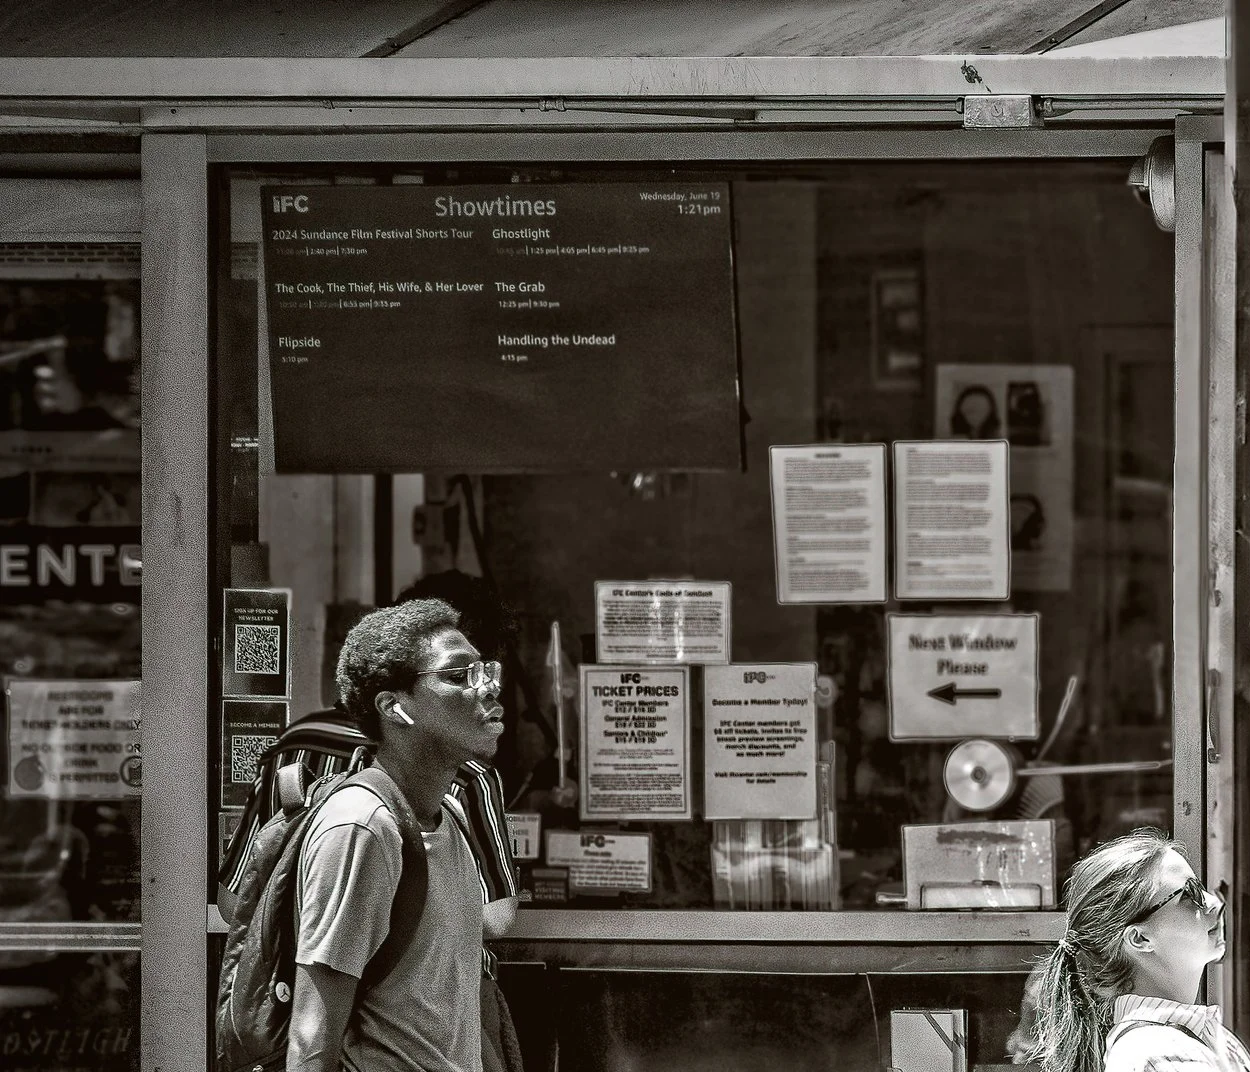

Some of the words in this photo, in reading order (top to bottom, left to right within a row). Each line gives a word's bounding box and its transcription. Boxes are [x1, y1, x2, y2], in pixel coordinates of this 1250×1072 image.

[639, 192, 687, 201] Wednesday,
[689, 192, 708, 200] June
[710, 192, 720, 200] 19
[434, 195, 556, 217] Showtimes
[272, 229, 298, 241] 2024
[300, 228, 349, 240] Sundance
[351, 228, 373, 240] Film
[375, 228, 413, 240] Festival
[416, 227, 449, 239] Shorts
[451, 228, 474, 239] Tour
[492, 228, 550, 241] Ghostlight
[275, 283, 294, 293] The
[296, 282, 325, 294] Cook,
[326, 282, 346, 293] The
[348, 282, 376, 294] Thief,
[378, 282, 394, 292] His
[397, 282, 422, 293] Wife,
[424, 282, 433, 292] &
[435, 282, 453, 292] Her
[456, 282, 484, 292] Lover
[494, 281, 516, 292] The
[518, 281, 546, 293] Grab
[278, 336, 321, 348] Flipside
[498, 334, 549, 347] Handling
[551, 334, 569, 346] the
[572, 334, 616, 346] Undead
[0, 544, 141, 586] ENTE
[908, 633, 946, 651] Next
[949, 633, 1018, 651] Window
[936, 658, 990, 676] Please
[592, 685, 633, 697] TICKET
[636, 685, 679, 697] PRICES
